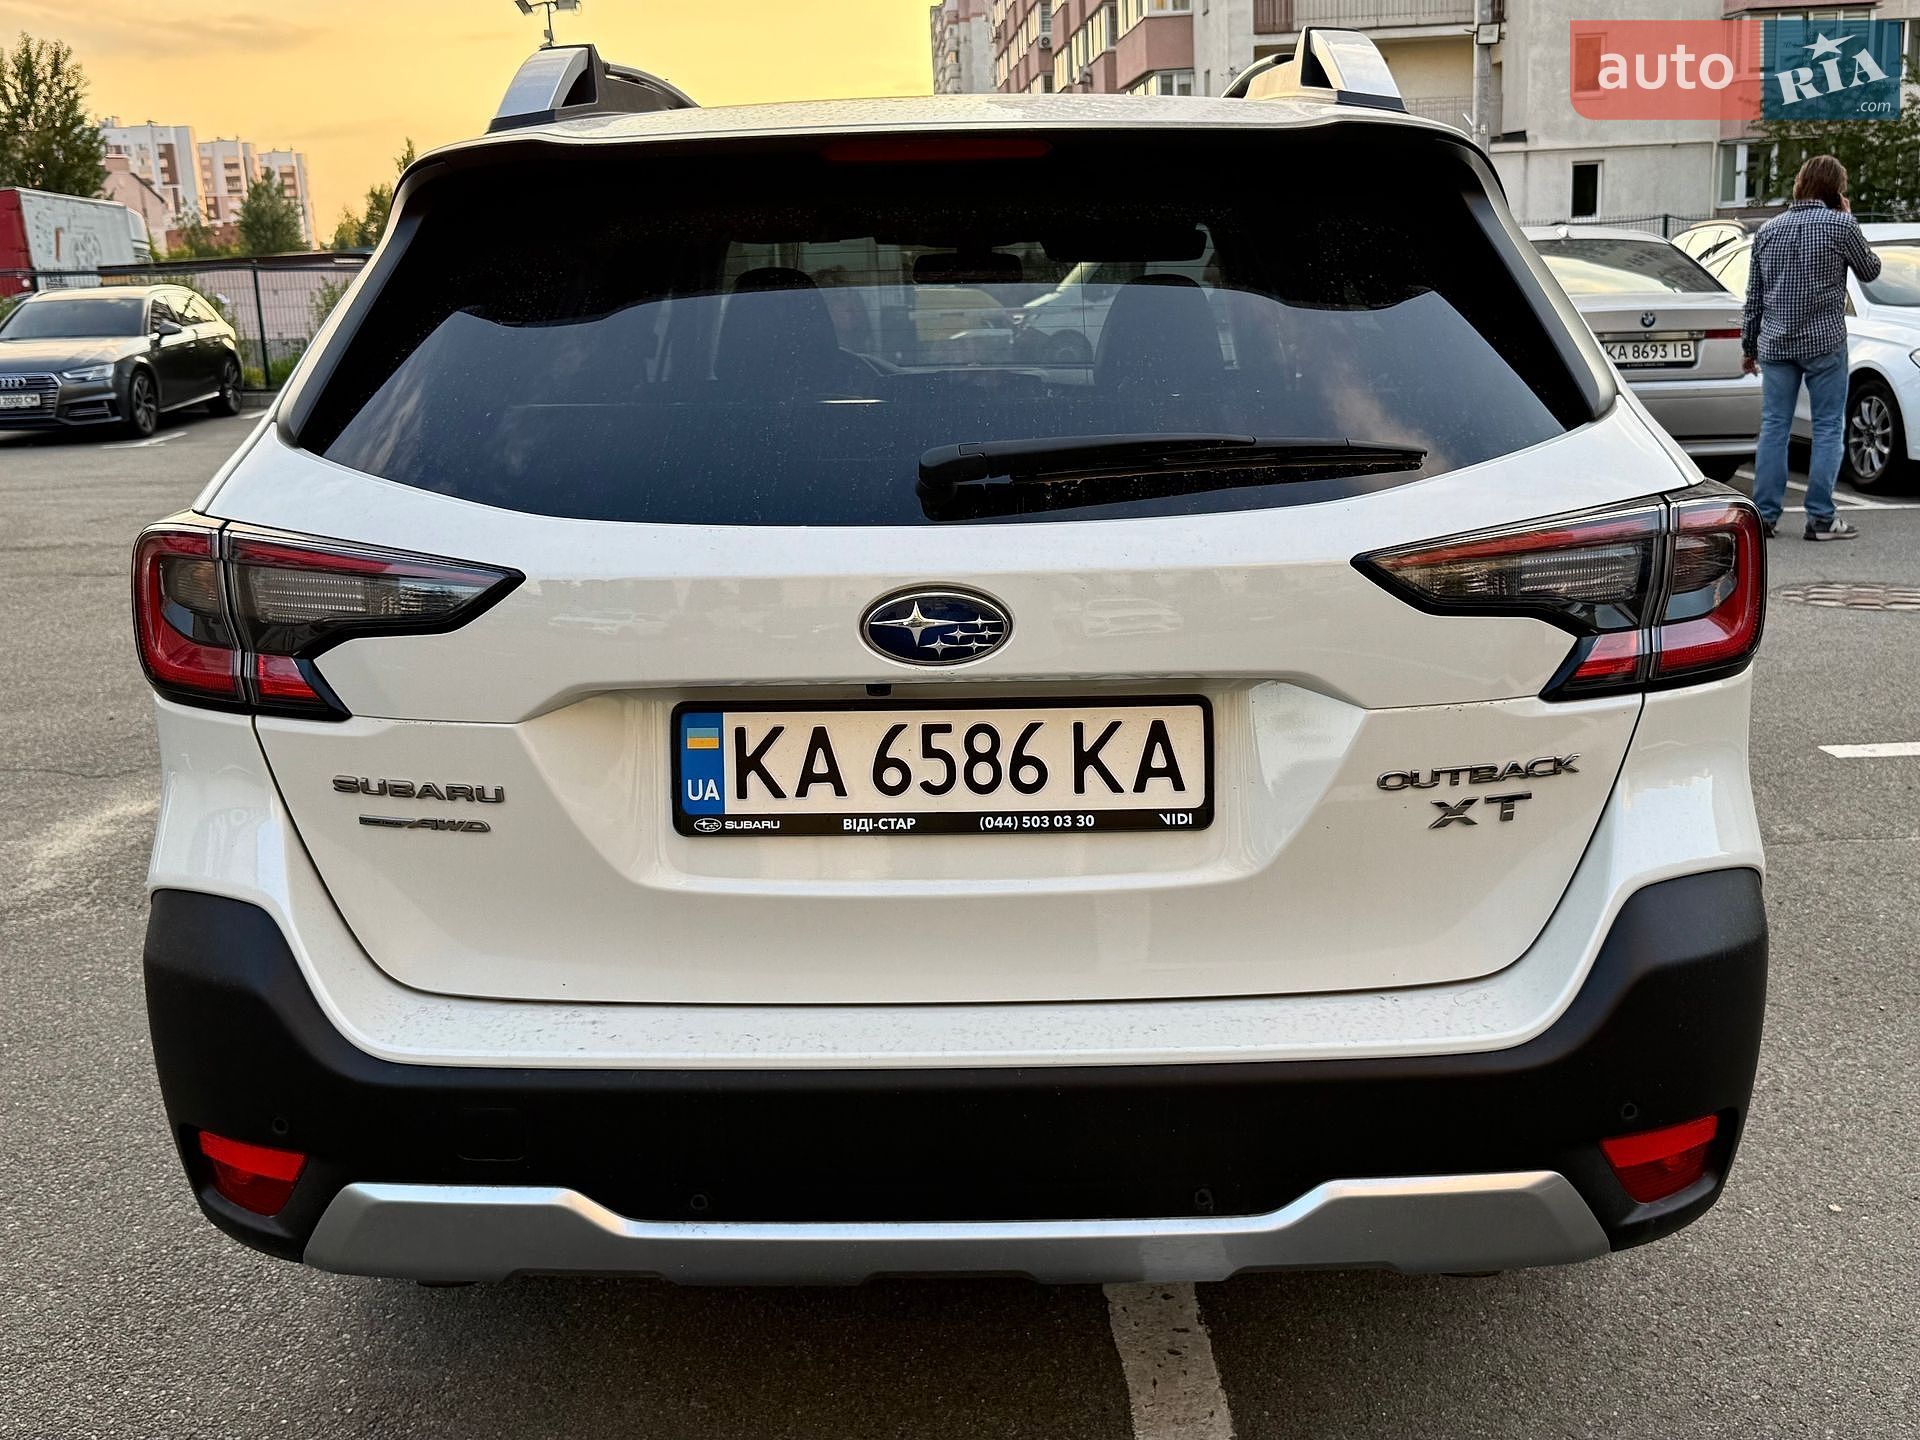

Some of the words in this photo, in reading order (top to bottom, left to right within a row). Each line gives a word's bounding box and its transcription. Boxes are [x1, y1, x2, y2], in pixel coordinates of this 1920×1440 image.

[1605, 345, 1628, 360] KA
[1632, 344, 1667, 359] 8693
[1673, 343, 1692, 358] IB
[734, 726, 848, 800] KA
[871, 721, 1048, 797] 6586
[1072, 719, 1186, 794] KA
[1376, 752, 1582, 791] OUTBACK
[332, 774, 505, 804] SUBARU
[687, 780, 720, 801] UA
[1428, 790, 1533, 830] XT
[407, 816, 492, 832] AWD
[724, 820, 781, 830] SUBARU
[842, 818, 917, 832] ВІДІ-СТАР
[979, 816, 1019, 831] (044)
[1021, 815, 1050, 829] 503
[1053, 815, 1072, 828] 03
[1076, 814, 1095, 828] 30
[1158, 812, 1193, 826] VIDI
